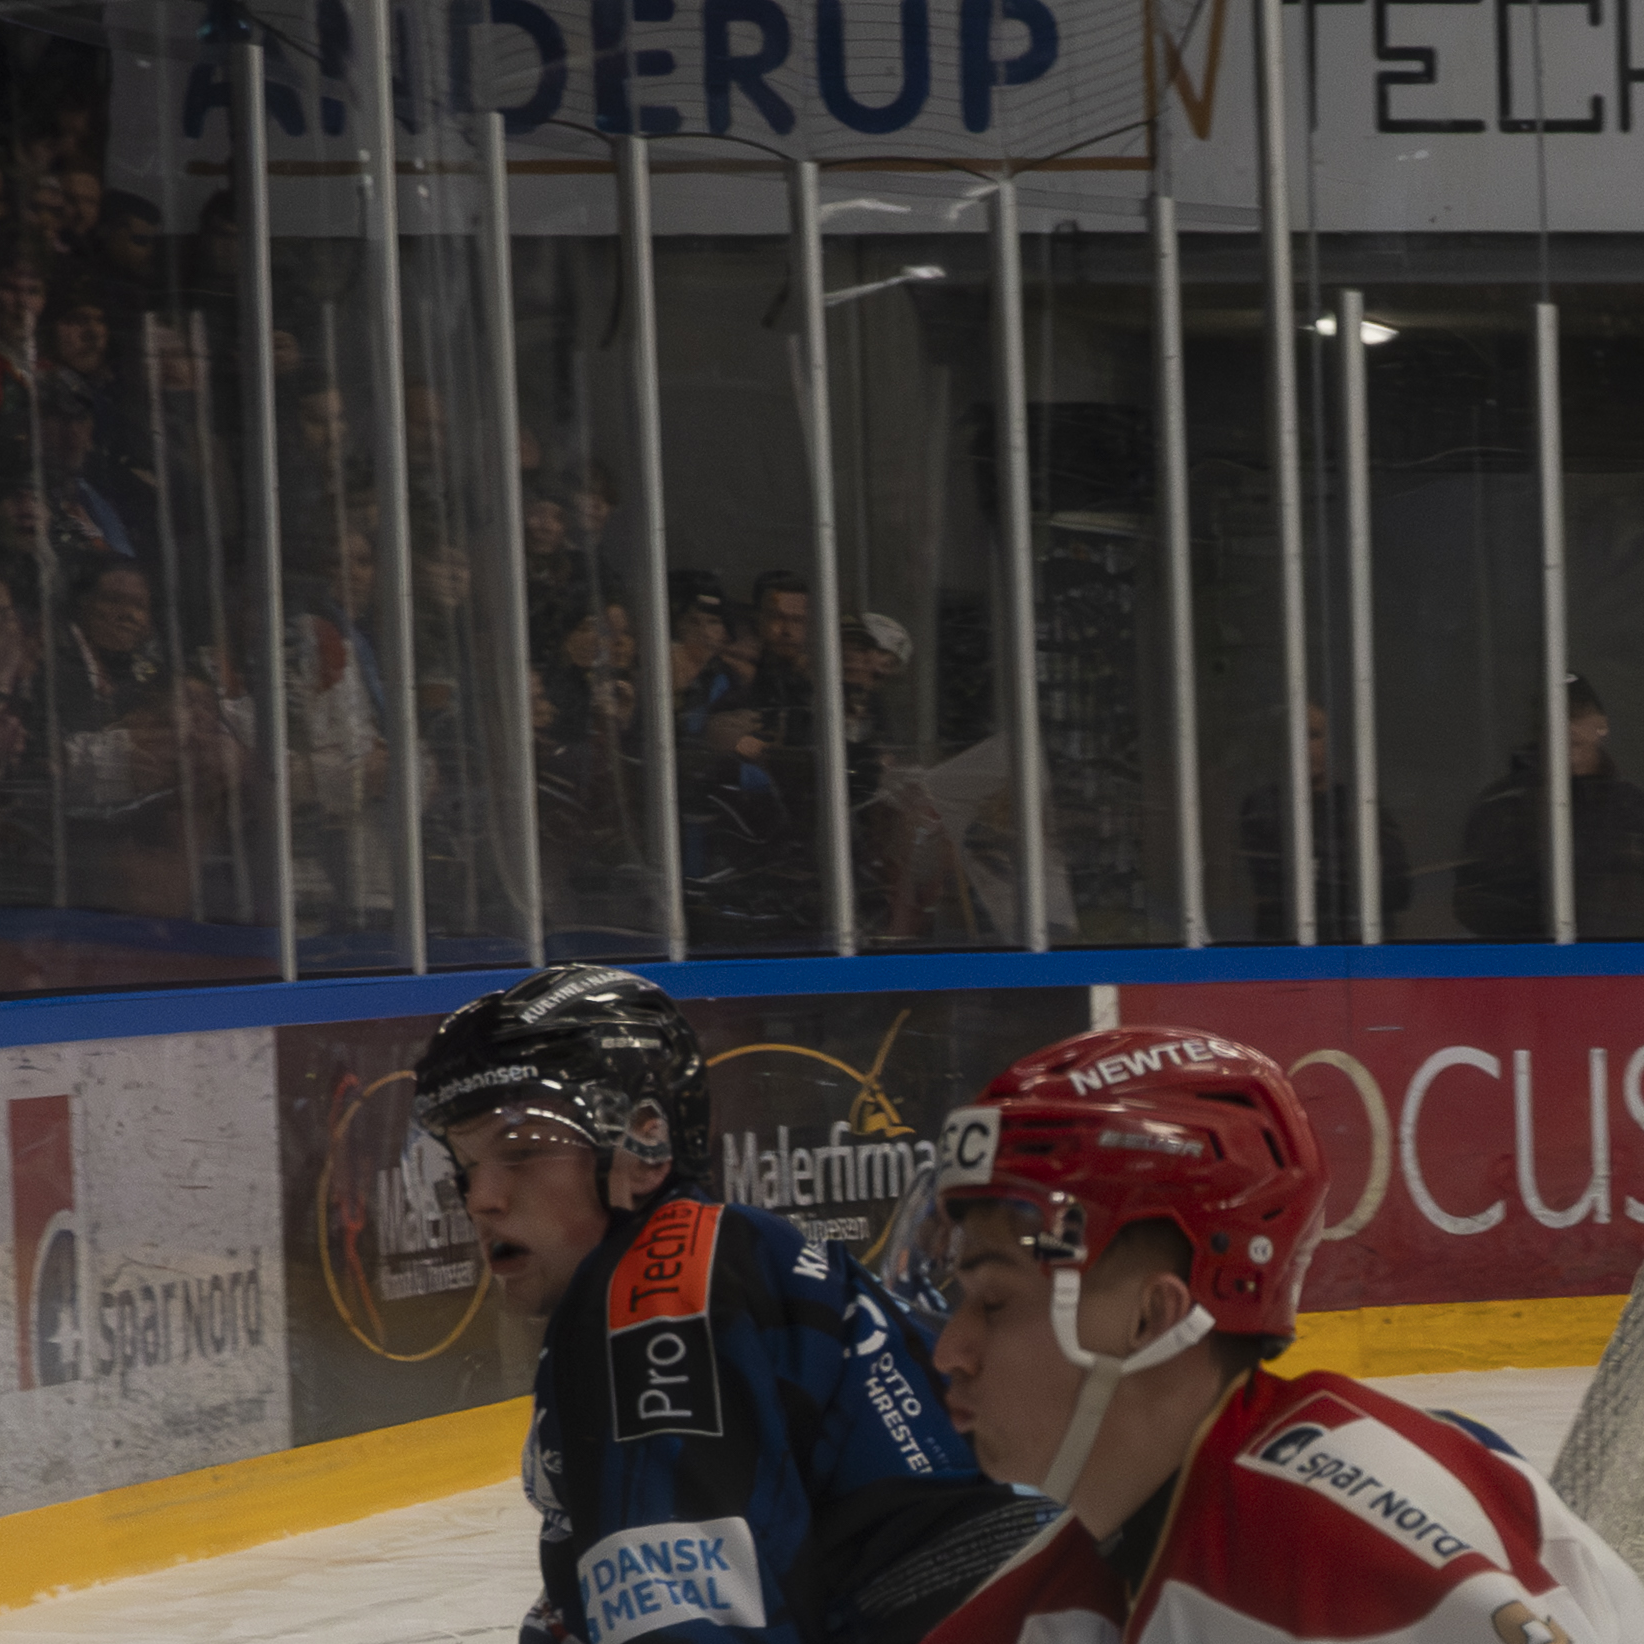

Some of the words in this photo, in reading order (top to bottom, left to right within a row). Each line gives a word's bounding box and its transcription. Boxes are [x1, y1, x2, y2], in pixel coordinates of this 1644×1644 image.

[638, 1332, 693, 1420] Pro
[879, 1352, 922, 1417] OTTO
[592, 1537, 731, 1594] DANSK
[602, 1576, 732, 1631] METAL
